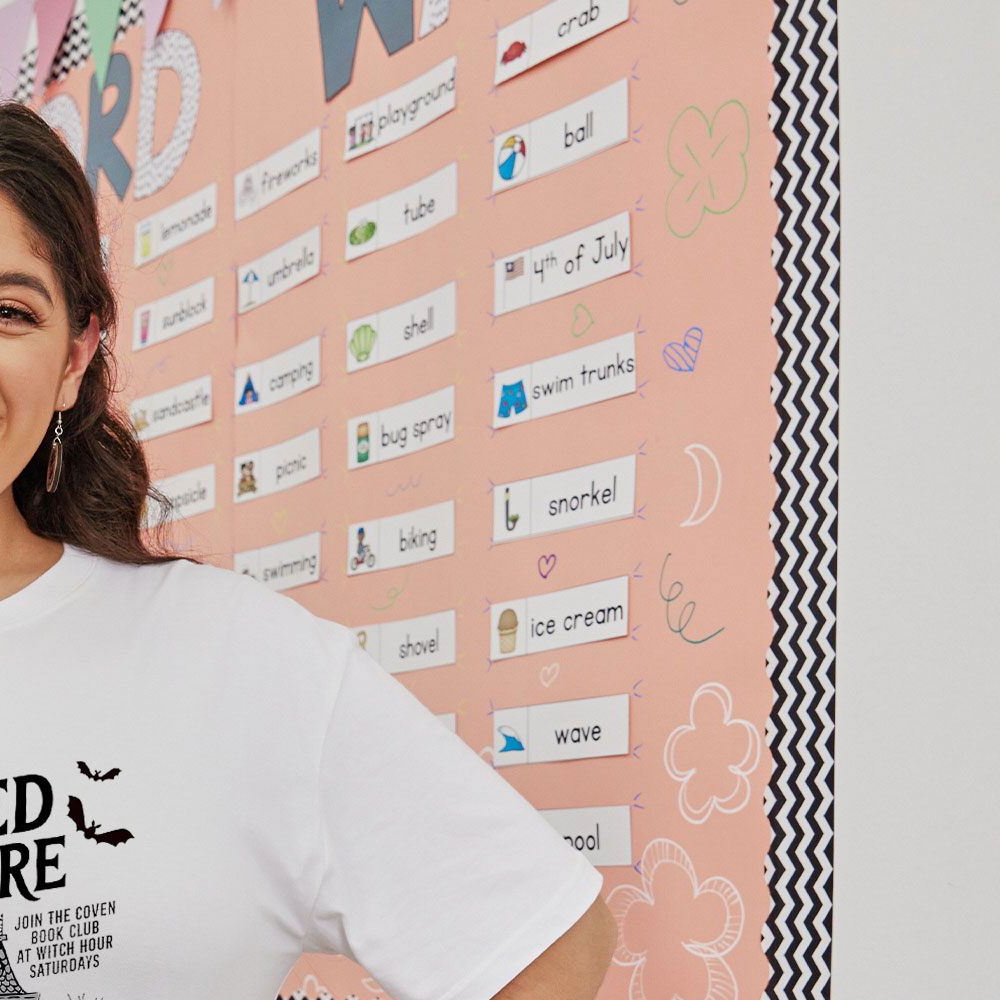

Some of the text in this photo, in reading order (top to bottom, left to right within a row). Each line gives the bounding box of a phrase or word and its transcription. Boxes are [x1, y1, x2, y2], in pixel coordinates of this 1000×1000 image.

[557, 0, 600, 38] crab
[378, 66, 457, 136] playground
[564, 110, 594, 149] ball
[261, 147, 318, 194] fireworks
[161, 199, 213, 241] lemonade
[403, 195, 436, 225] tube
[266, 246, 315, 288] umbrella
[534, 230, 629, 283] 4th of July
[161, 292, 207, 330] sunblock
[403, 306, 434, 341] shell
[268, 361, 314, 392] camping
[531, 352, 636, 400] swim trunks
[152, 387, 210, 423] sandcastle
[380, 411, 453, 449] bug spray
[275, 456, 307, 485] picnic
[548, 475, 617, 517] snorkel
[399, 525, 438, 552] biking
[262, 554, 317, 583] swimming
[530, 604, 624, 638] ice cream
[399, 627, 440, 660] shovel
[554, 725, 602, 745] wave
[14, 900, 117, 931] JOIN THE COVEN
[31, 920, 100, 945] BOOK CLUB
[16, 935, 113, 964] AT WITCH HOUR
[29, 954, 100, 979] SATURDAYS
